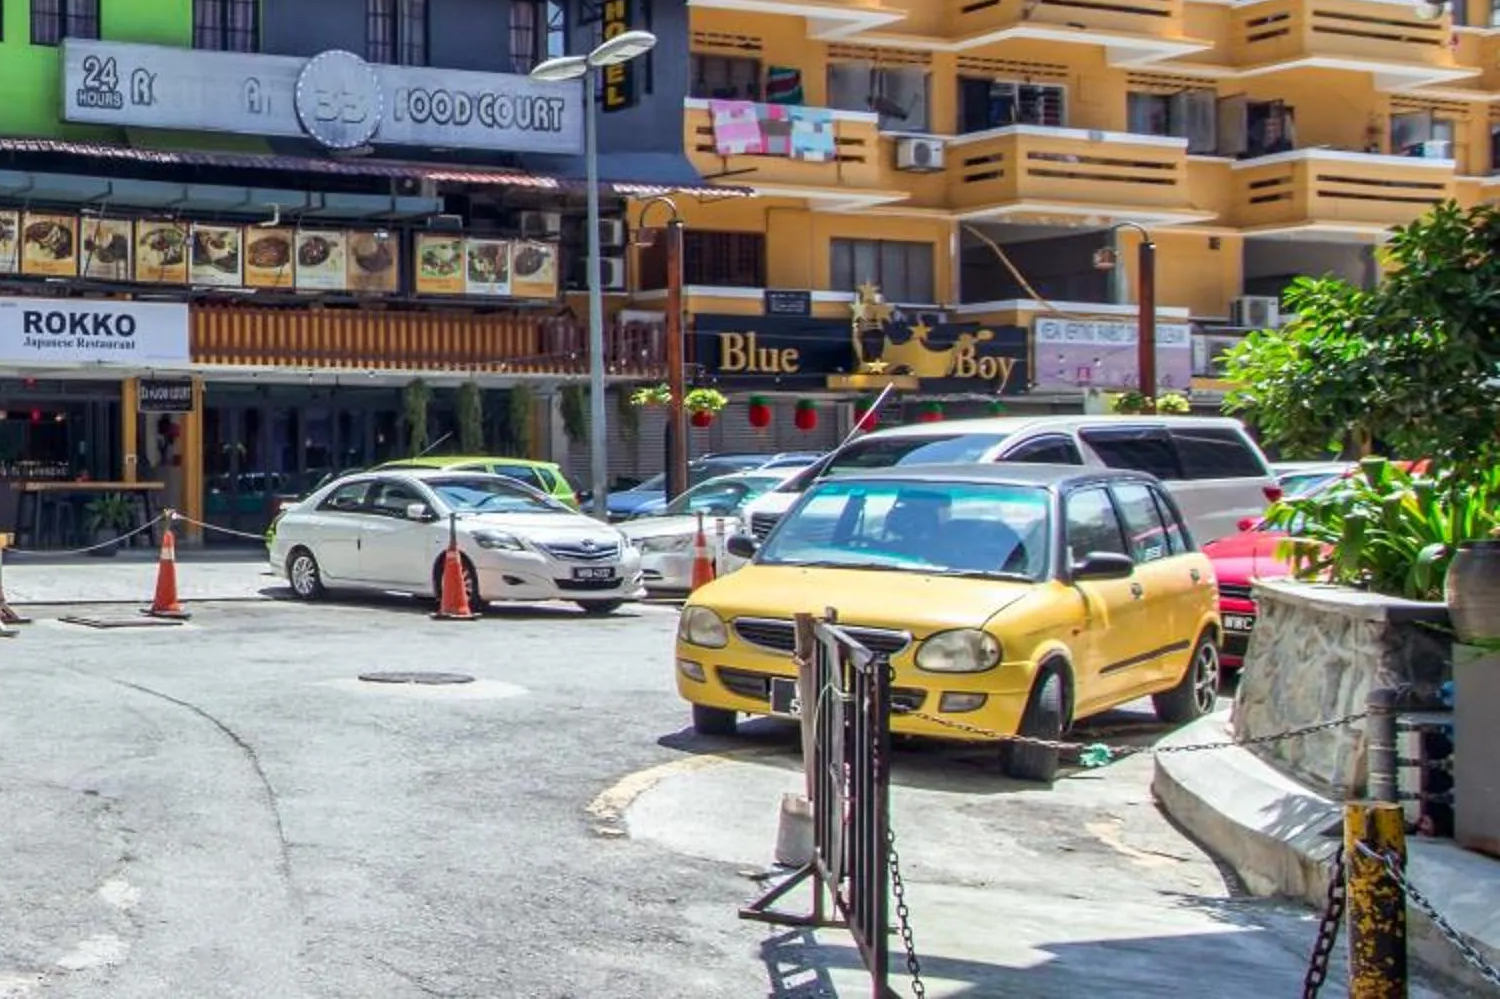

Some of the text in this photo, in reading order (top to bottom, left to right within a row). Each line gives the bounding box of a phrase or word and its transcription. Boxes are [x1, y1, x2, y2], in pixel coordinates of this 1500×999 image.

[84, 55, 119, 91] 24
[76, 88, 123, 110] HOURS
[479, 91, 565, 132] COURT
[22, 310, 137, 338] ROKKO
[23, 336, 136, 351] Japanese Restaurant
[718, 331, 1017, 392] Blue Boy
